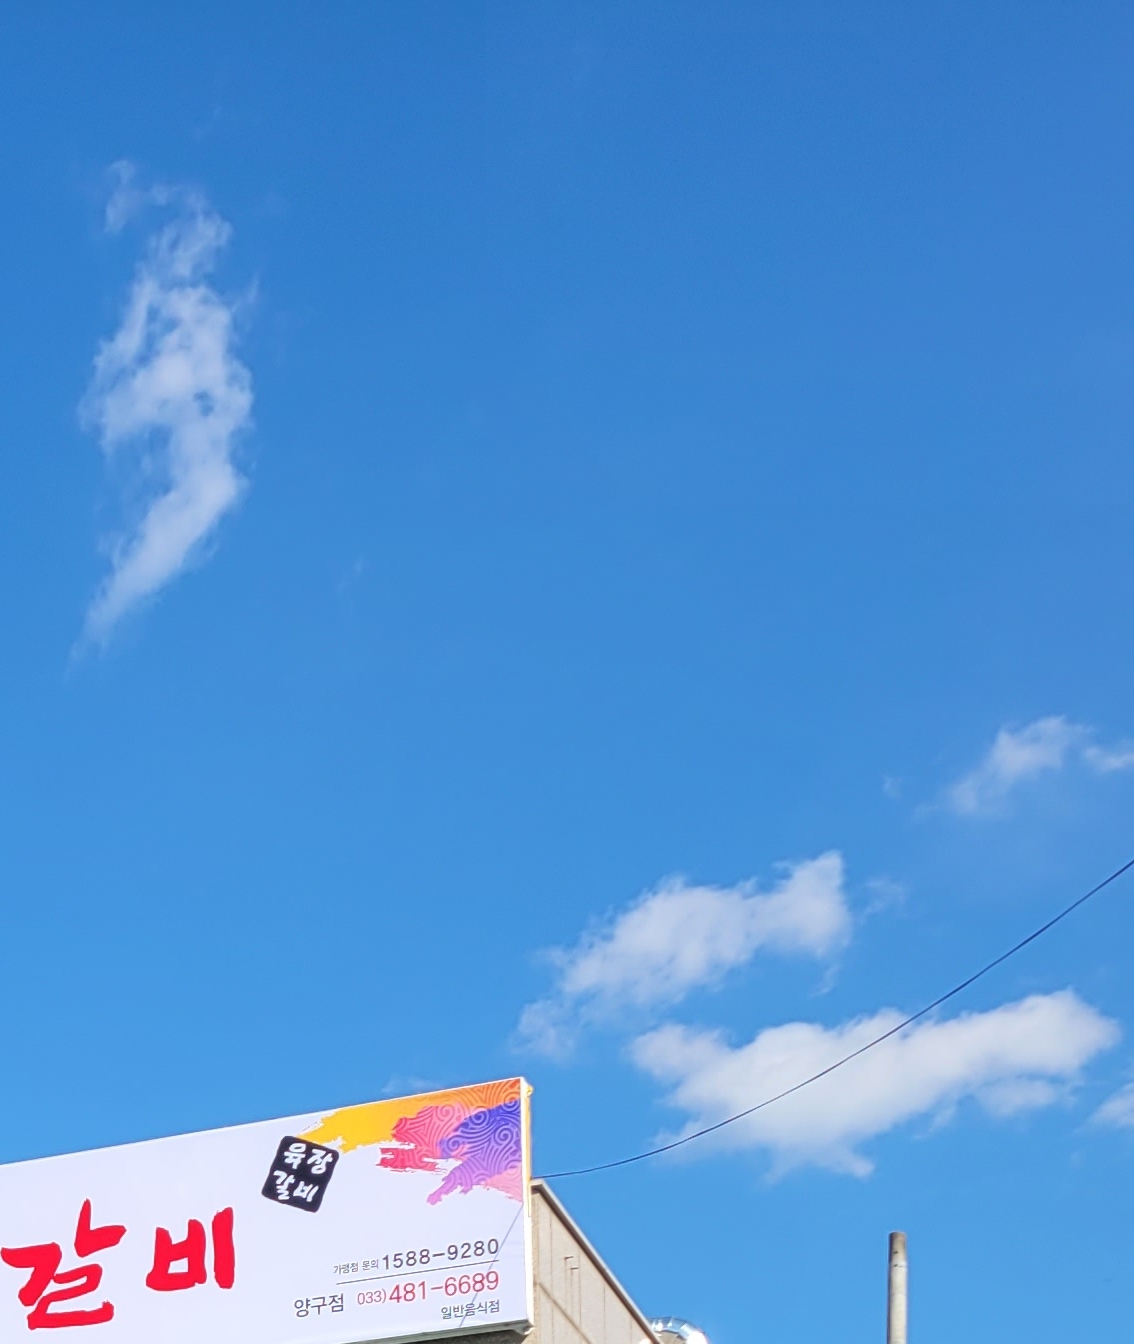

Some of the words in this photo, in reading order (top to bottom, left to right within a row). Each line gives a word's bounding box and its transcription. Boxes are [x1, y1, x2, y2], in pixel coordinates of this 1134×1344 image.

[283, 1142, 334, 1174] 육장
[272, 1170, 319, 1203] 갈비
[362, 1259, 379, 1271] 문의
[382, 1238, 500, 1271] 1588-9280
[294, 1293, 345, 1317] 양구점
[440, 1299, 501, 1320] 일반음식점
